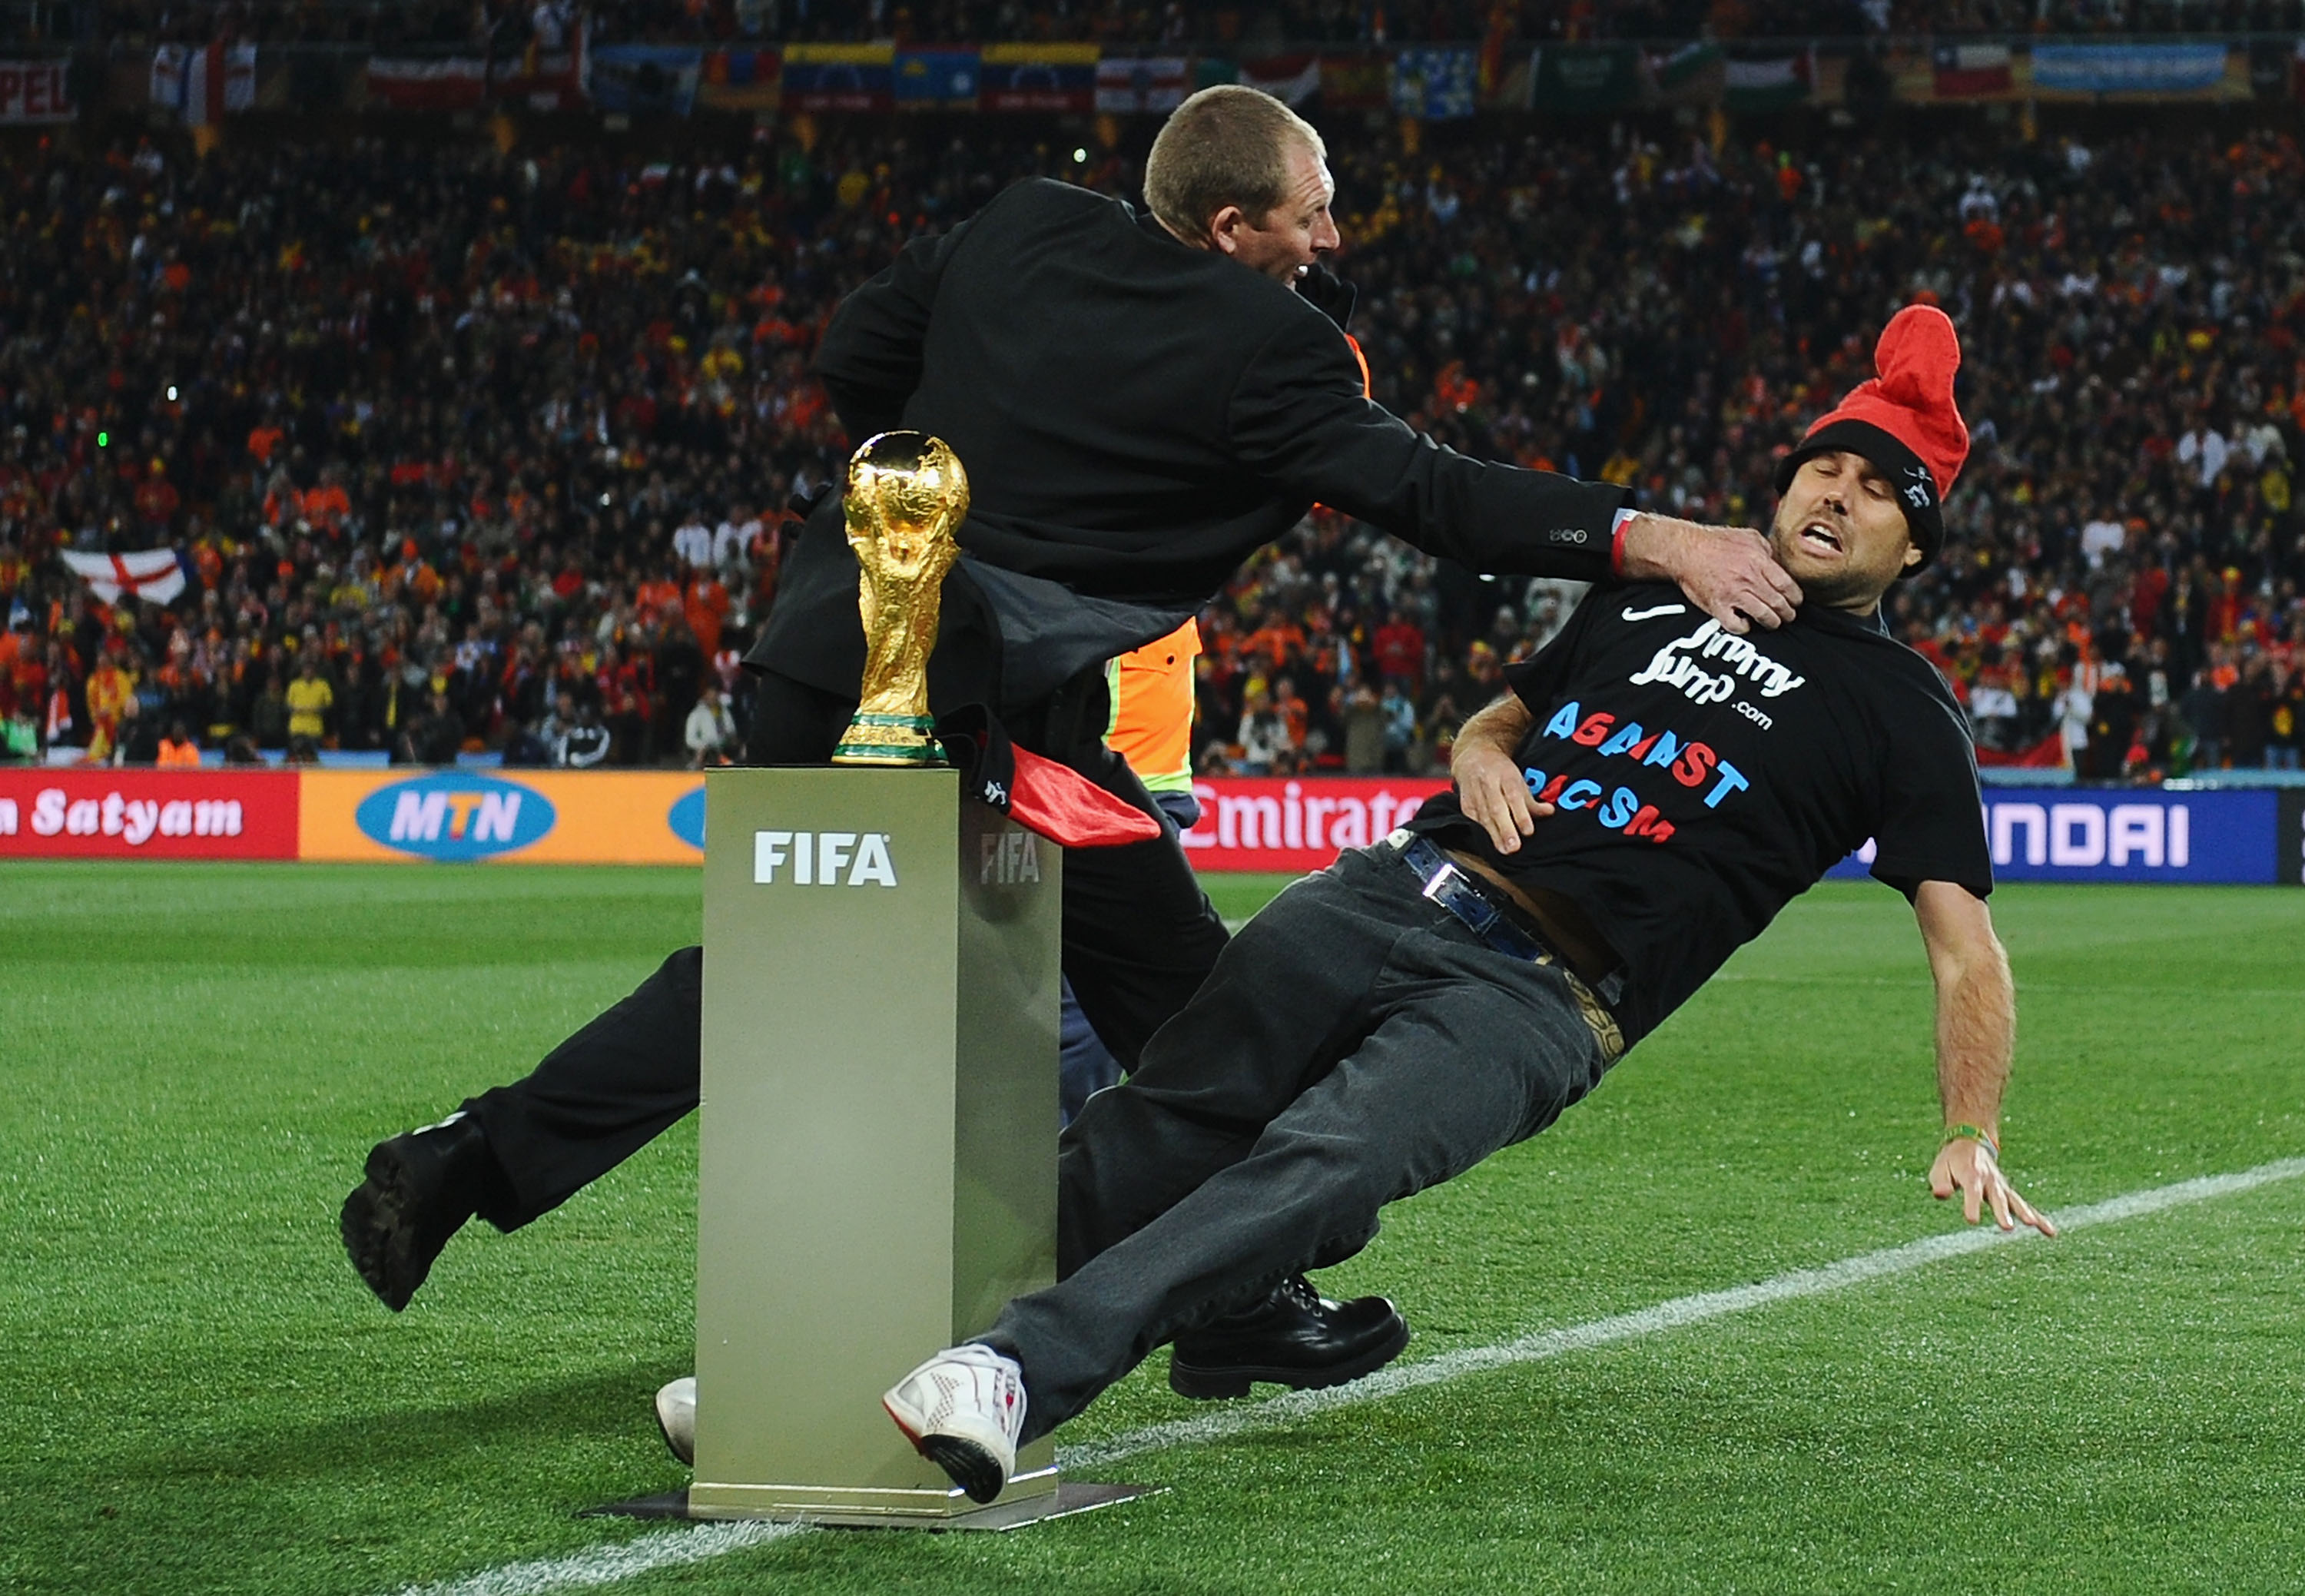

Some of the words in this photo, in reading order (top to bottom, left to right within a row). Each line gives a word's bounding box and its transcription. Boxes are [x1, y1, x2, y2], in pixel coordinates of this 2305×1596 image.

[1667, 618, 1806, 698] Jimmy
[1731, 700, 1773, 731] .com
[1543, 701, 1749, 808] AGAINST
[31, 788, 243, 846] Satyam
[390, 790, 522, 842] MTN
[1524, 767, 1676, 843] ACSM
[754, 831, 897, 888] FIFA
[979, 831, 1040, 885] FIFA
[1982, 803, 2189, 868] NDAI
